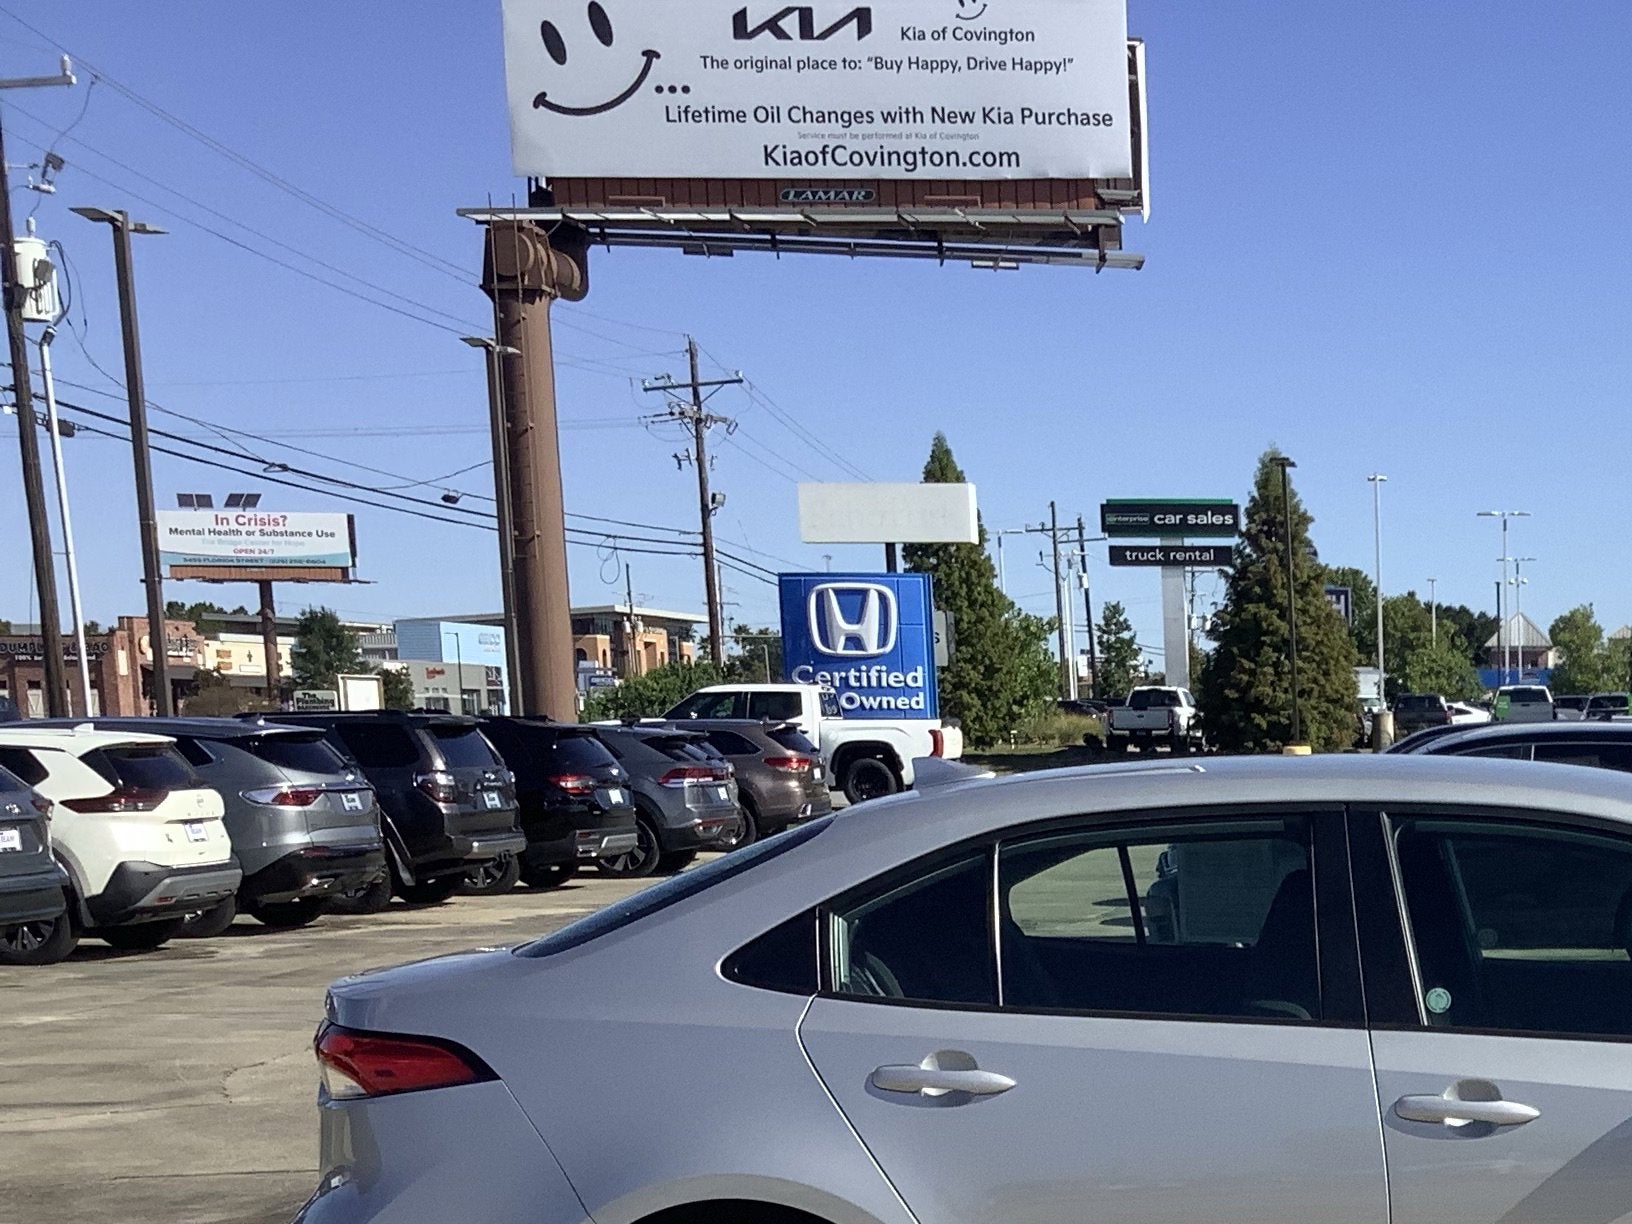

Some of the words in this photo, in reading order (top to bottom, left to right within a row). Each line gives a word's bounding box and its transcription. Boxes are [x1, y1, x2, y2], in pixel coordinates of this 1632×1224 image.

[900, 26, 926, 41] Kia
[931, 26, 948, 41] of
[952, 26, 1036, 45] Covington
[700, 55, 729, 70] The
[733, 55, 792, 73] original
[797, 56, 838, 73] place
[841, 57, 863, 70] to:
[908, 56, 962, 74] Happy,
[966, 56, 1007, 71] Drive
[665, 105, 747, 124] Lifetime
[753, 105, 781, 124] Oil
[787, 105, 875, 128] Changes
[880, 106, 924, 125] with
[931, 106, 976, 125] New
[982, 107, 1014, 125] Kia
[1020, 107, 1113, 127] Purchase
[914, 132, 927, 140] Kia
[939, 132, 980, 141] Covington
[763, 144, 1021, 172] KiaofCovington.com
[787, 189, 866, 200] LAMAR
[214, 514, 230, 526] In
[235, 514, 288, 527] Crisis?
[1153, 513, 1183, 524] car
[1187, 510, 1234, 525] sales
[168, 527, 205, 536] Mental
[208, 527, 243, 537] Health
[245, 529, 256, 537] or
[259, 528, 313, 538] Substance
[316, 529, 336, 538] Use
[1125, 549, 1165, 561] truck
[1170, 549, 1215, 561] rental
[791, 665, 924, 688] Certified
[839, 691, 925, 710] Owned
